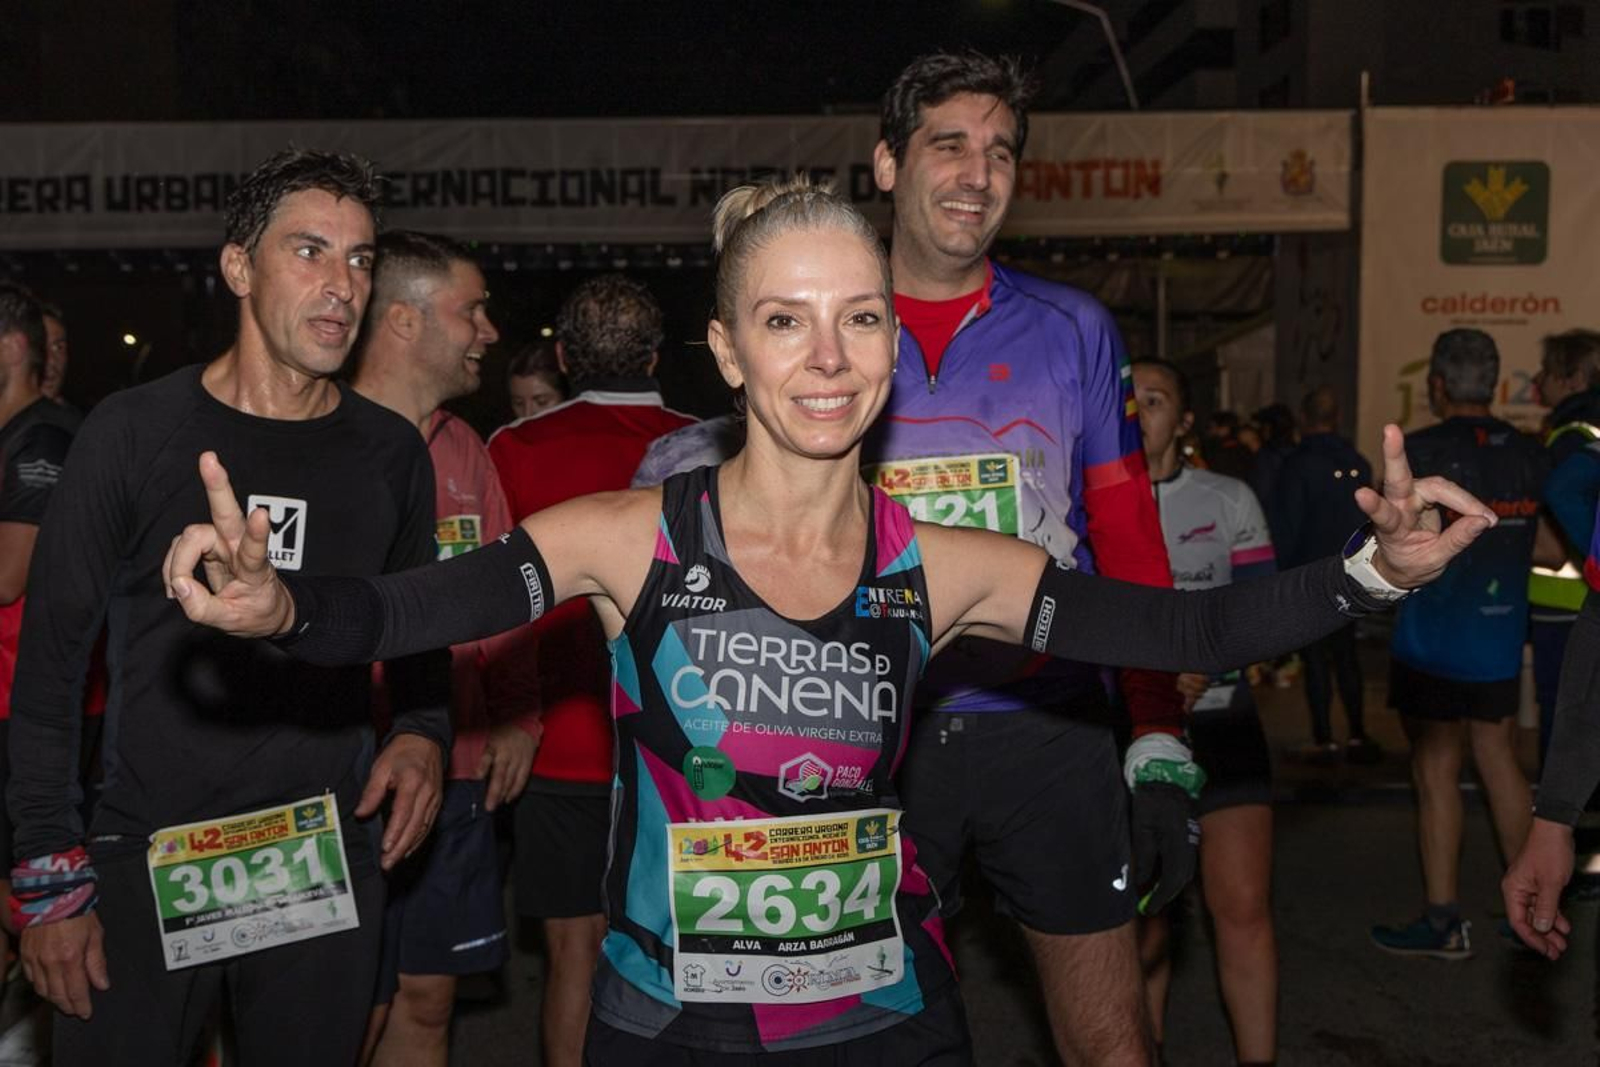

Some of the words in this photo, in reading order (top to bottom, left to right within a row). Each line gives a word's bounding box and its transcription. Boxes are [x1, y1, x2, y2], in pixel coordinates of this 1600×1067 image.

[0, 174, 91, 213] ERA
[105, 171, 256, 213] URBAN
[380, 166, 676, 207] ERNACIONAL
[267, 550, 296, 561] LLET
[661, 593, 727, 613] VIATOR
[683, 718, 729, 733] ACEITE
[733, 721, 751, 734] DE
[755, 723, 794, 737] OLIVA
[798, 727, 846, 741] VIRGEN
[849, 730, 883, 745] EXTRA
[836, 765, 862, 778] PACO
[188, 827, 224, 852] 42
[724, 831, 769, 862] 42
[769, 825, 813, 837] CARRERA
[815, 822, 849, 834] URBANA
[769, 844, 800, 860] SAN
[803, 838, 849, 856] ANTON
[169, 834, 325, 914] 3031
[692, 862, 881, 936] 2634
[733, 940, 761, 950] ALVA
[778, 942, 806, 951] ARZA
